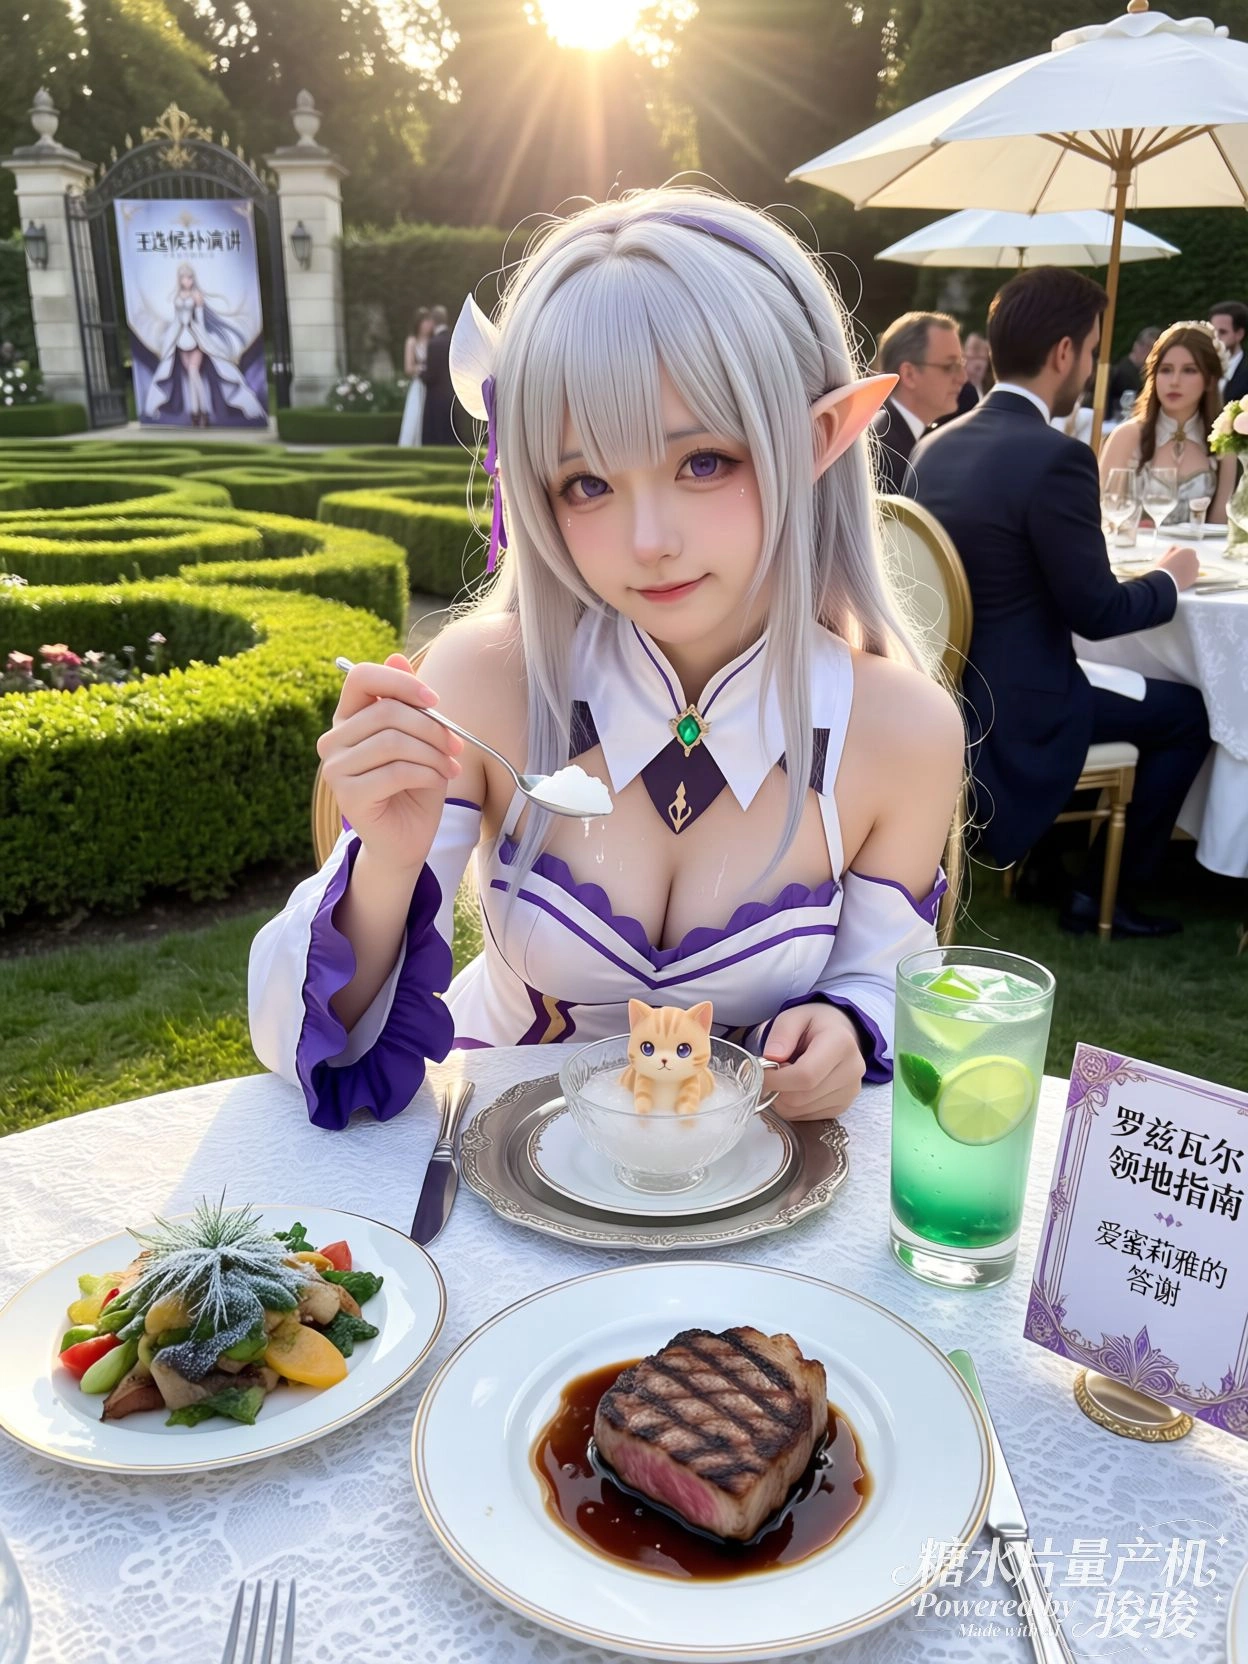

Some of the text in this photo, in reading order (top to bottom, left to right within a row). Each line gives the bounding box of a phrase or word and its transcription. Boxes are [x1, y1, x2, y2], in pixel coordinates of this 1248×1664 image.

[1110, 1106, 1244, 1174] 罗兹瓦尔
[1108, 1145, 1244, 1221] 领地指南
[1095, 1221, 1228, 1289] 爱蜜莉雅的
[1126, 1264, 1181, 1307] 答谢
